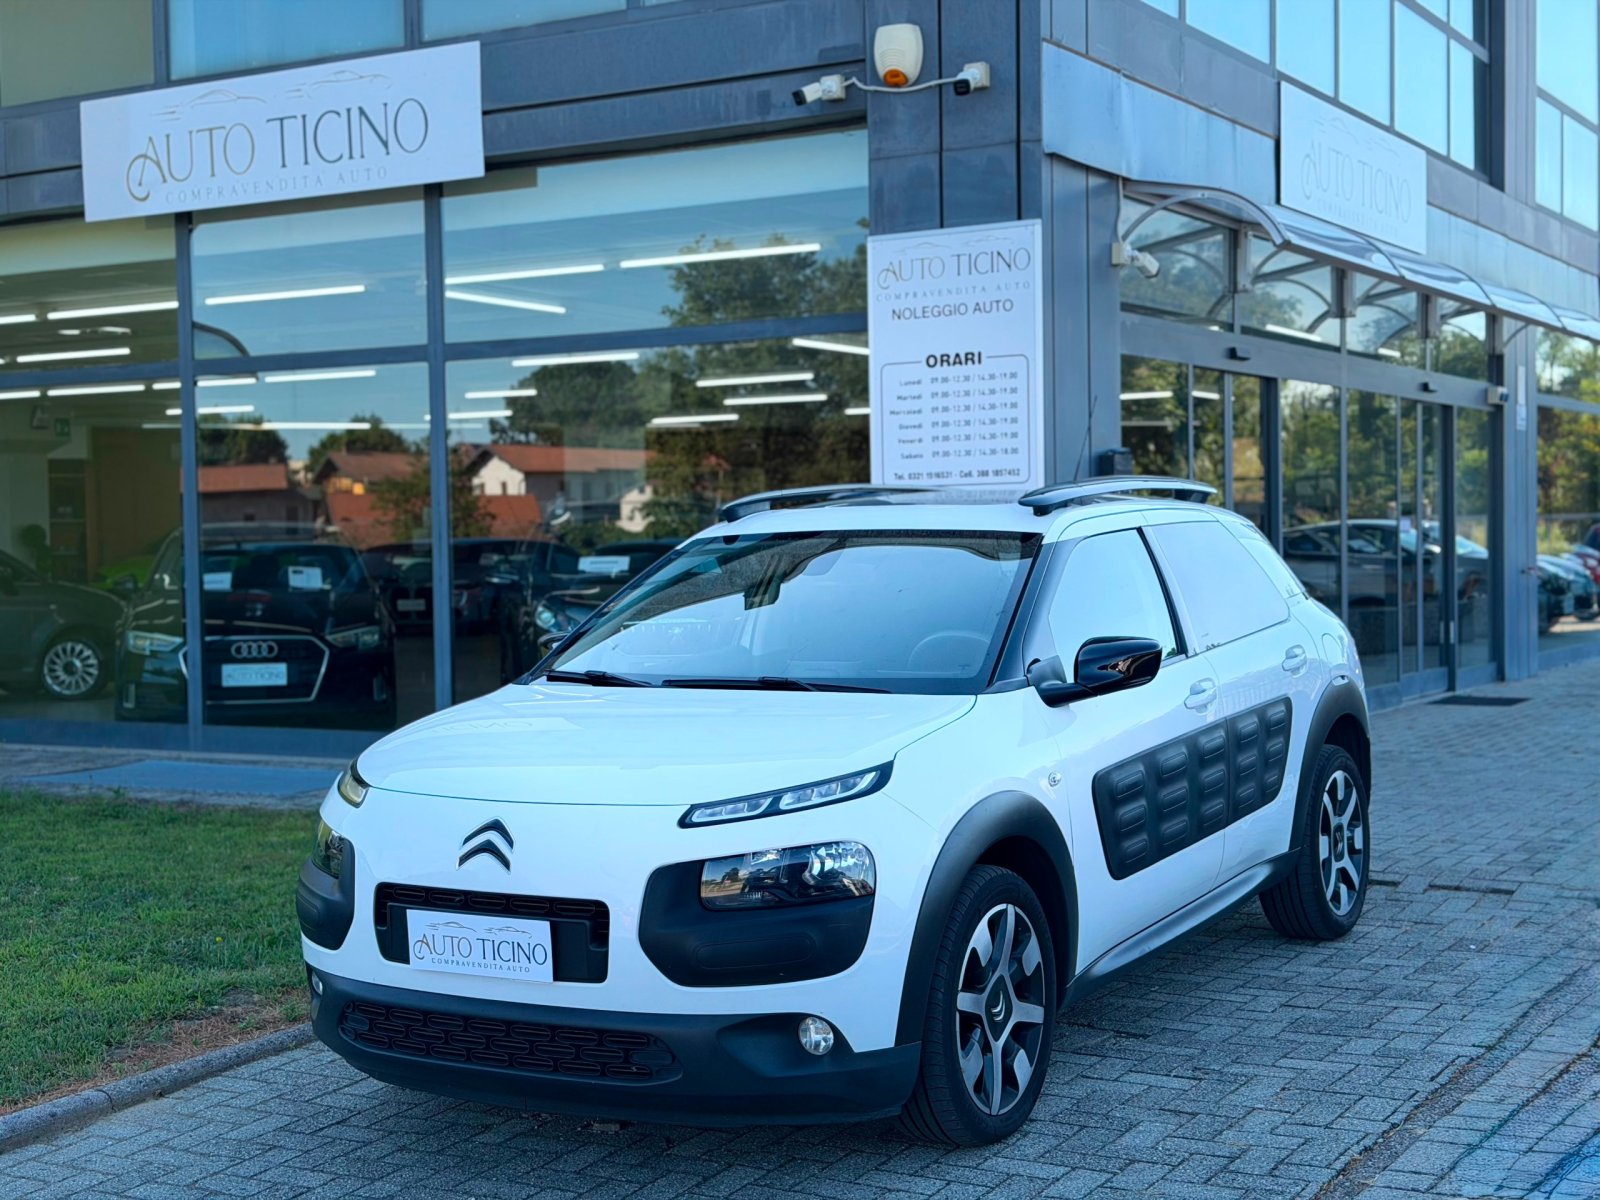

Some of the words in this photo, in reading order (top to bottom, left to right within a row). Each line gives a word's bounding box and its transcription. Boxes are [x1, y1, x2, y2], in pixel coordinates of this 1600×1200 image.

[126, 121, 255, 202] AUTO
[266, 98, 429, 169] TICINO
[165, 174, 325, 206] COMPRAVENDITA
[336, 166, 388, 185] AUTO
[1301, 140, 1355, 202] AUTO
[1358, 159, 1412, 224] TICINO
[876, 255, 946, 290] AUTO
[951, 247, 1031, 277] TICINO
[876, 285, 987, 302] COMPRAVENDITA
[995, 281, 1031, 292] AUTO
[892, 302, 969, 321] NOLEGGIO
[973, 298, 1014, 315] AUTO
[925, 351, 982, 369] ORARI
[413, 933, 472, 960] AUTO
[476, 938, 548, 966] TICINO
[431, 957, 504, 971] COMPRAVENDITA
[507, 965, 530, 973] AUTO
